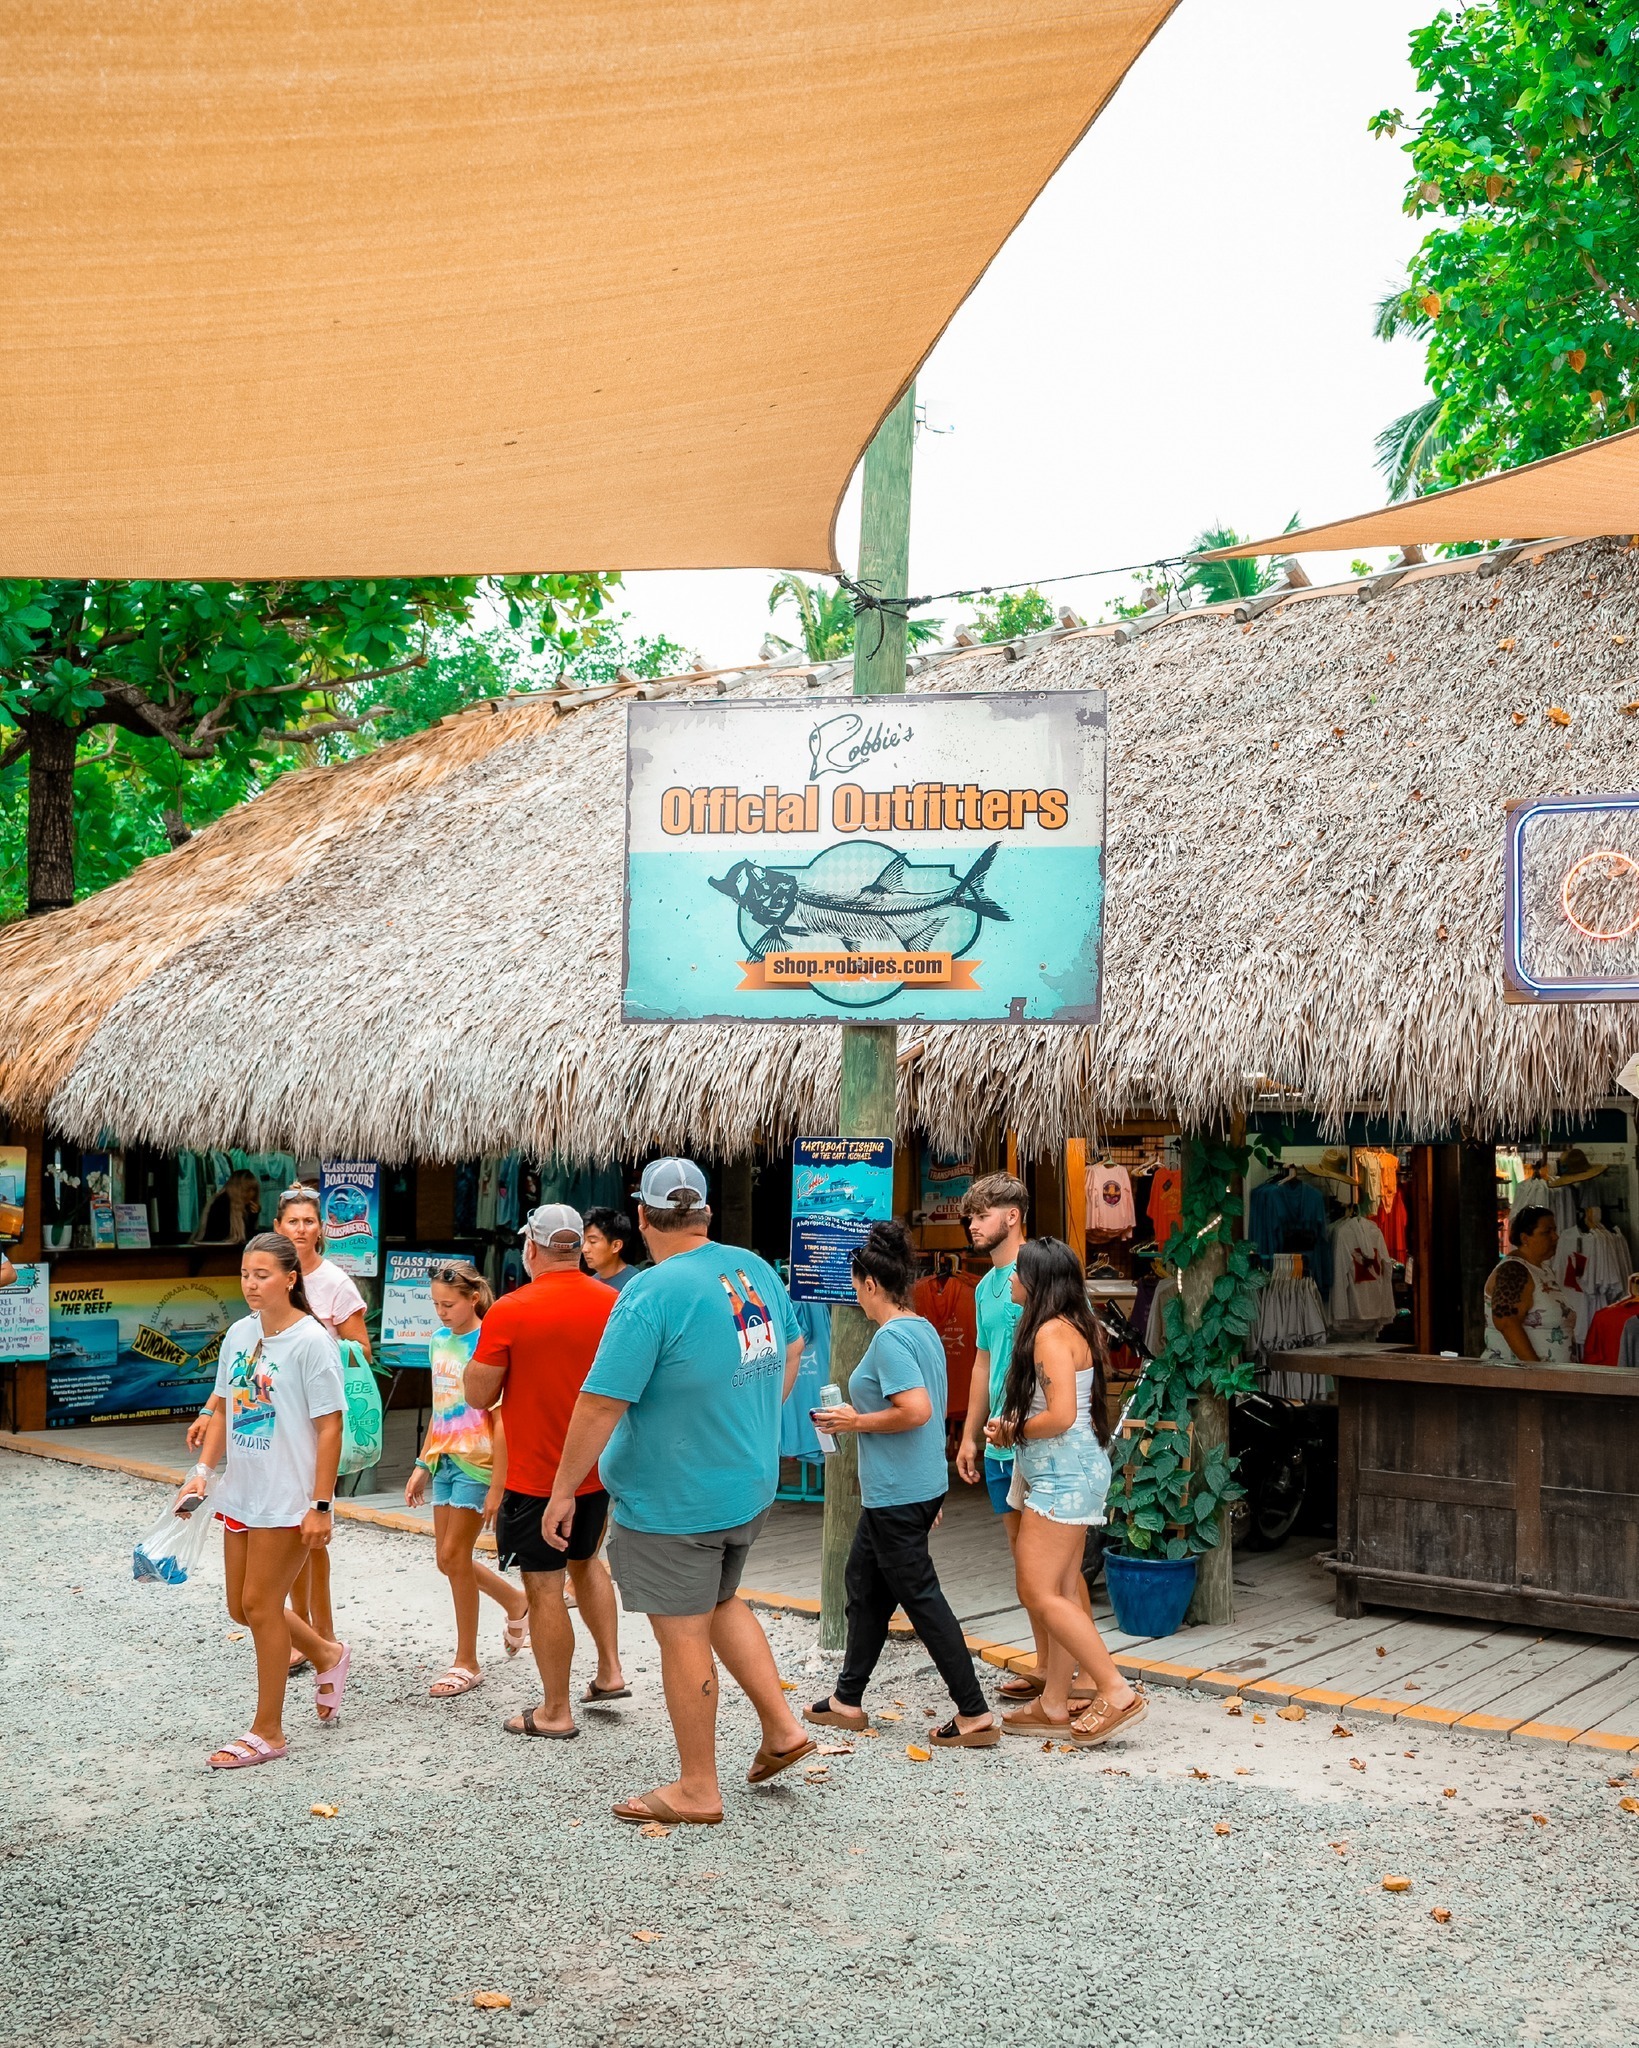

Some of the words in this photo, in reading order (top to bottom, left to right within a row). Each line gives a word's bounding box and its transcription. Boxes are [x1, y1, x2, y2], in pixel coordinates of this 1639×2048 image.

[809, 714, 914, 781] Robbie's
[661, 785, 820, 836] Official
[832, 782, 1069, 832] Outfitters
[772, 956, 943, 978] shop.robbies.com
[801, 1141, 849, 1152] PARTYBOAT
[849, 1141, 884, 1153] FISHING
[322, 1163, 345, 1173] GLASS
[346, 1163, 377, 1173] BOTTOM
[324, 1174, 346, 1188] BOAT
[347, 1174, 374, 1188] TOURS
[390, 1256, 423, 1266] GLASS
[393, 1267, 425, 1281] BOAT
[54, 1288, 104, 1302] SNORKEL
[190, 1283, 218, 1300] FLORIDA
[388, 1288, 406, 1304] Day
[61, 1303, 81, 1316] THE
[84, 1302, 112, 1315] REEF
[135, 1329, 186, 1363] SUNDANCE
[90, 1414, 112, 1422] Contact
[136, 1408, 171, 1418] ADVENTURE!
